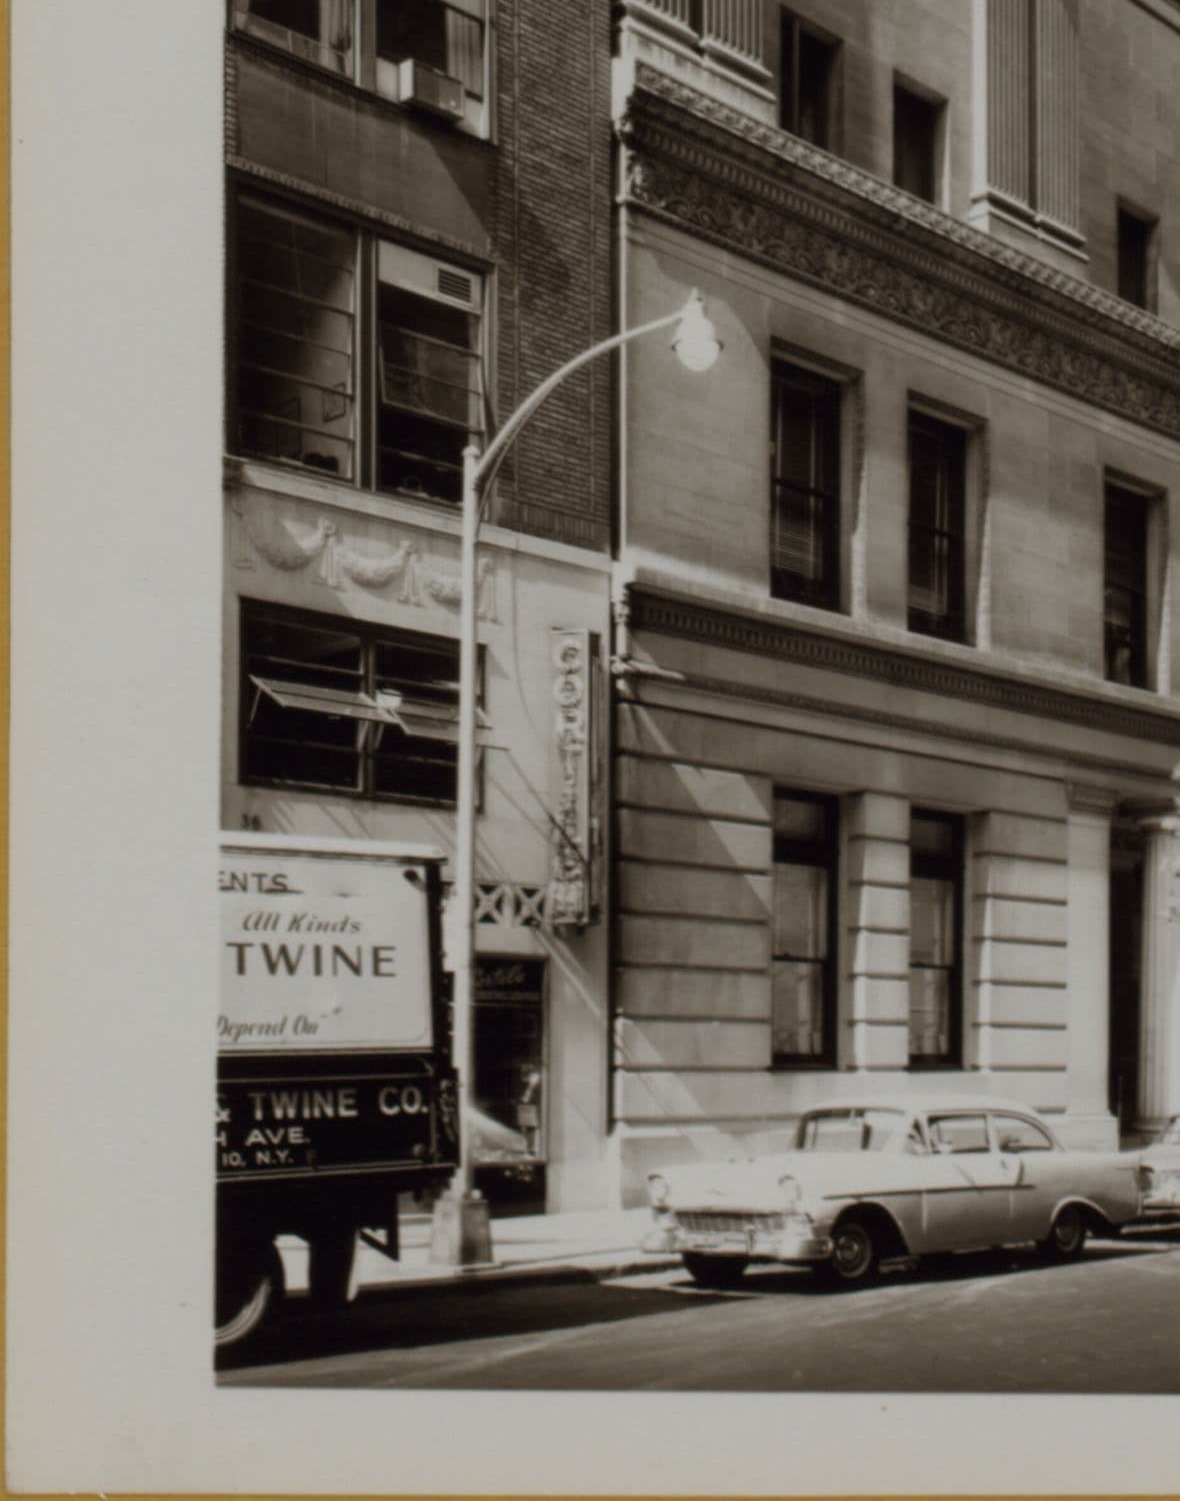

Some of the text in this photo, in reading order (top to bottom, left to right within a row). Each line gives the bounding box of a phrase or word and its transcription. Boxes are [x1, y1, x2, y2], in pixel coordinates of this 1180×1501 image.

[242, 910, 363, 934] All Kinds
[225, 941, 397, 978] TWINE
[247, 1088, 358, 1121] TWINE
[378, 1086, 429, 1116] CO.
[244, 1126, 312, 1147] AVE.
[255, 1148, 295, 1165] N.Y.
